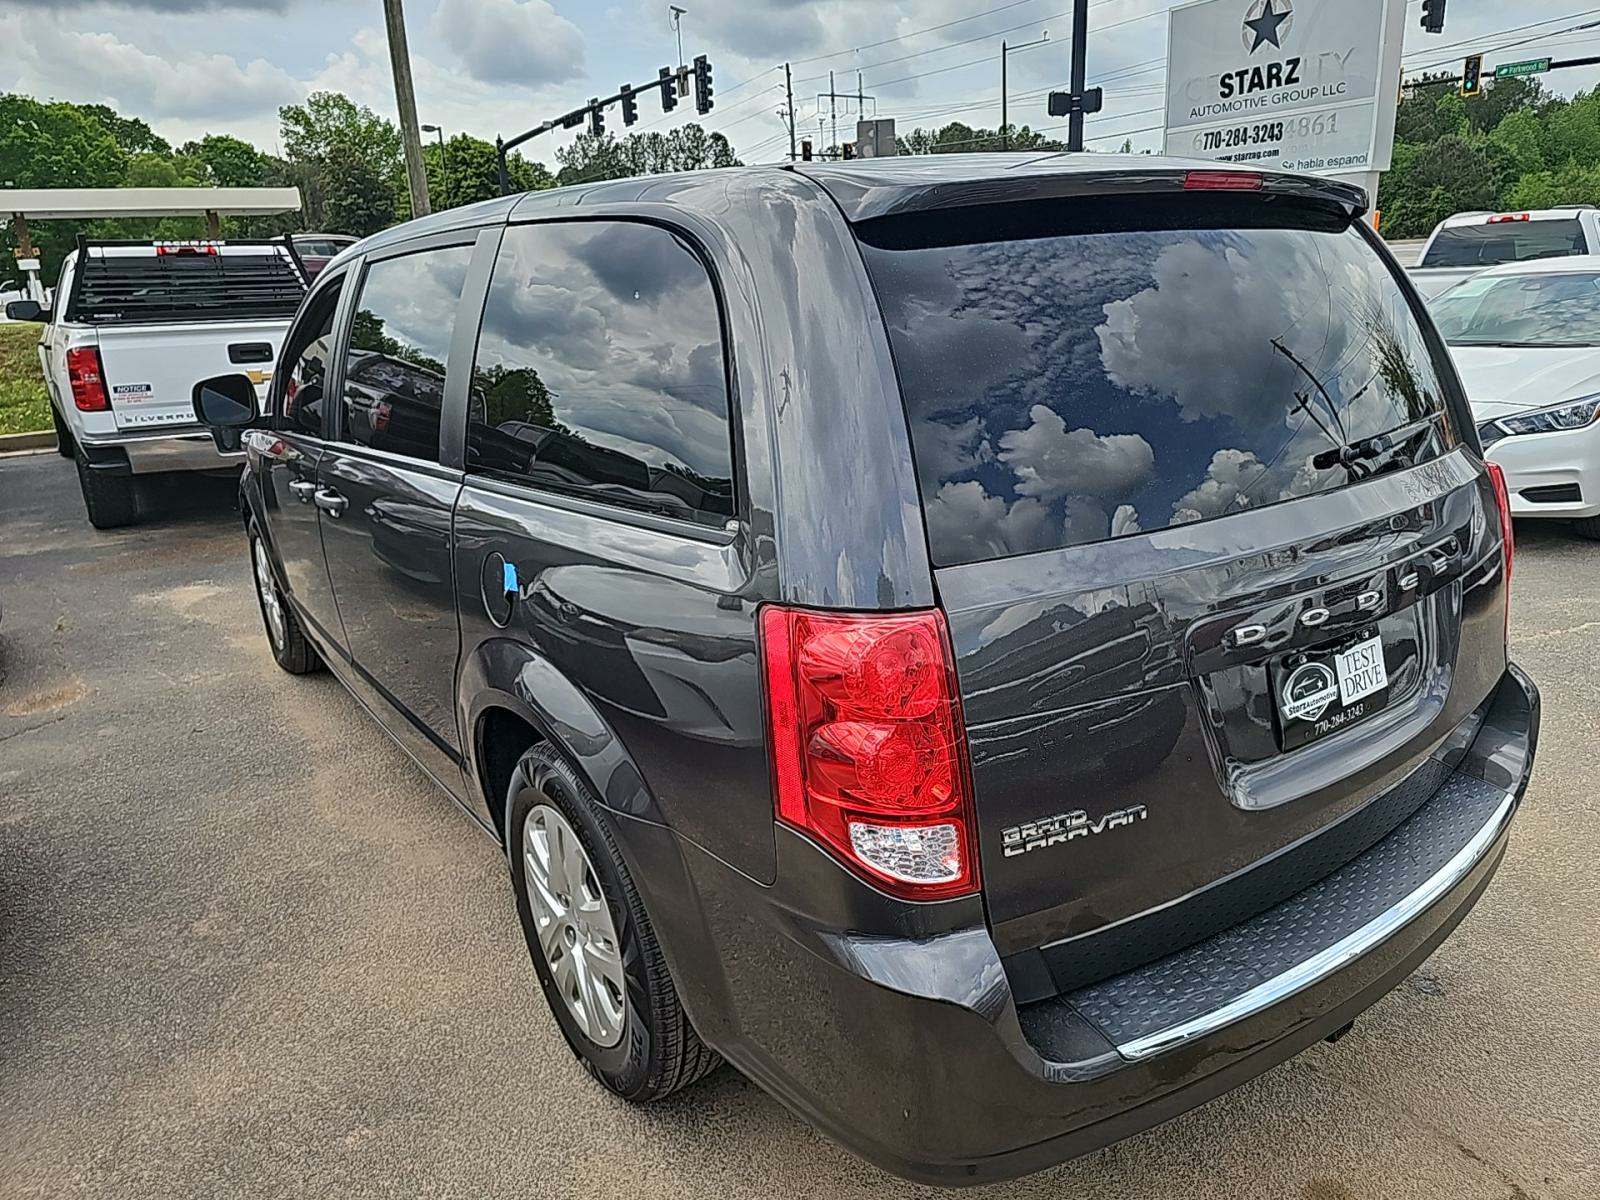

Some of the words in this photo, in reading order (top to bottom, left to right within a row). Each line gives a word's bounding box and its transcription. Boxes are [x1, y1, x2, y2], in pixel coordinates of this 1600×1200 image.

[1219, 56, 1301, 99] STARZ
[1508, 62, 1537, 74] Parkwood
[1189, 93, 1268, 119] AUTOMOTIVE
[1271, 86, 1319, 105] GROUP
[1322, 81, 1347, 97] LLC
[1202, 122, 1284, 151] 770-284-3243
[1297, 157, 1325, 170] habla
[1234, 556, 1449, 646] DODGE
[1342, 643, 1377, 675] TEST
[1344, 663, 1384, 698] DRIVE
[1314, 703, 1364, 736] 770-284-3243
[1001, 809, 1088, 844] GRAND
[1003, 803, 1148, 858] CARAVAN
